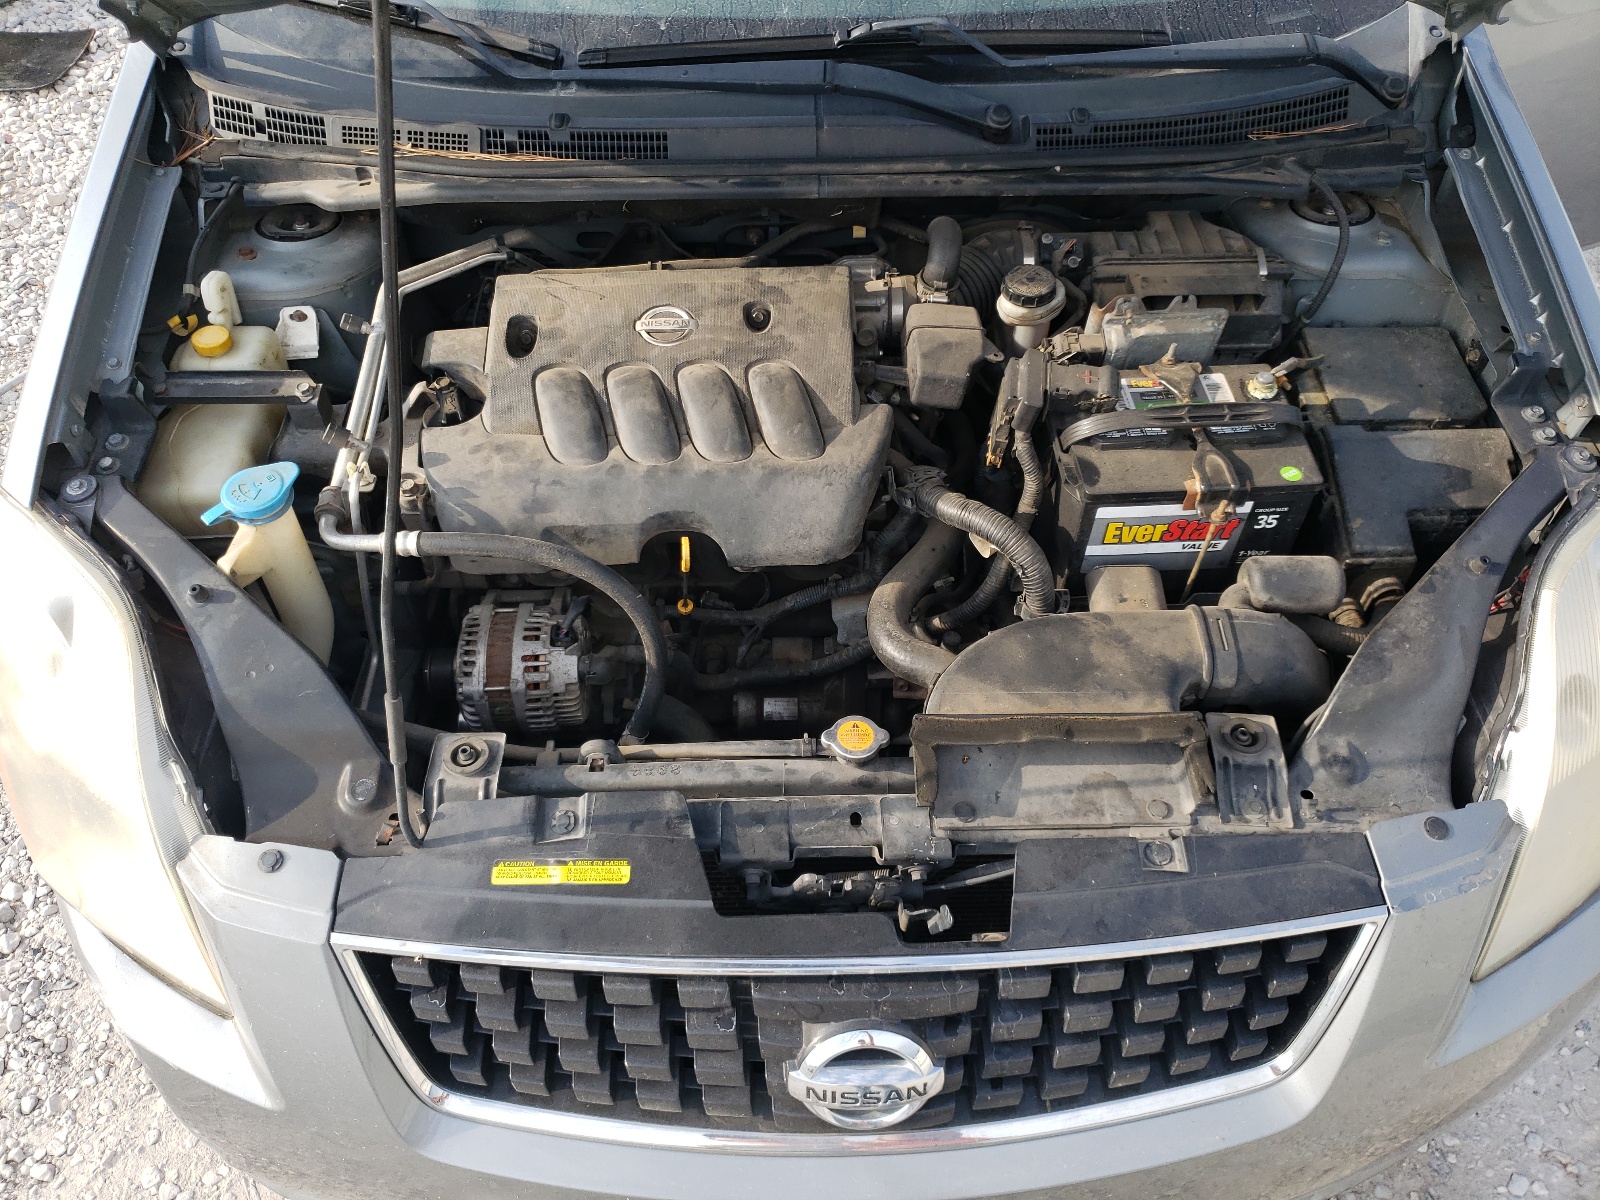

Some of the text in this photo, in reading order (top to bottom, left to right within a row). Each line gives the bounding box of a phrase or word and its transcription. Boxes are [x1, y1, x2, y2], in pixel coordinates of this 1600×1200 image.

[641, 319, 690, 327] NISSAN
[1103, 518, 1241, 544] EverStart
[1253, 514, 1280, 529] 35
[805, 1082, 928, 1105] NISSAN
